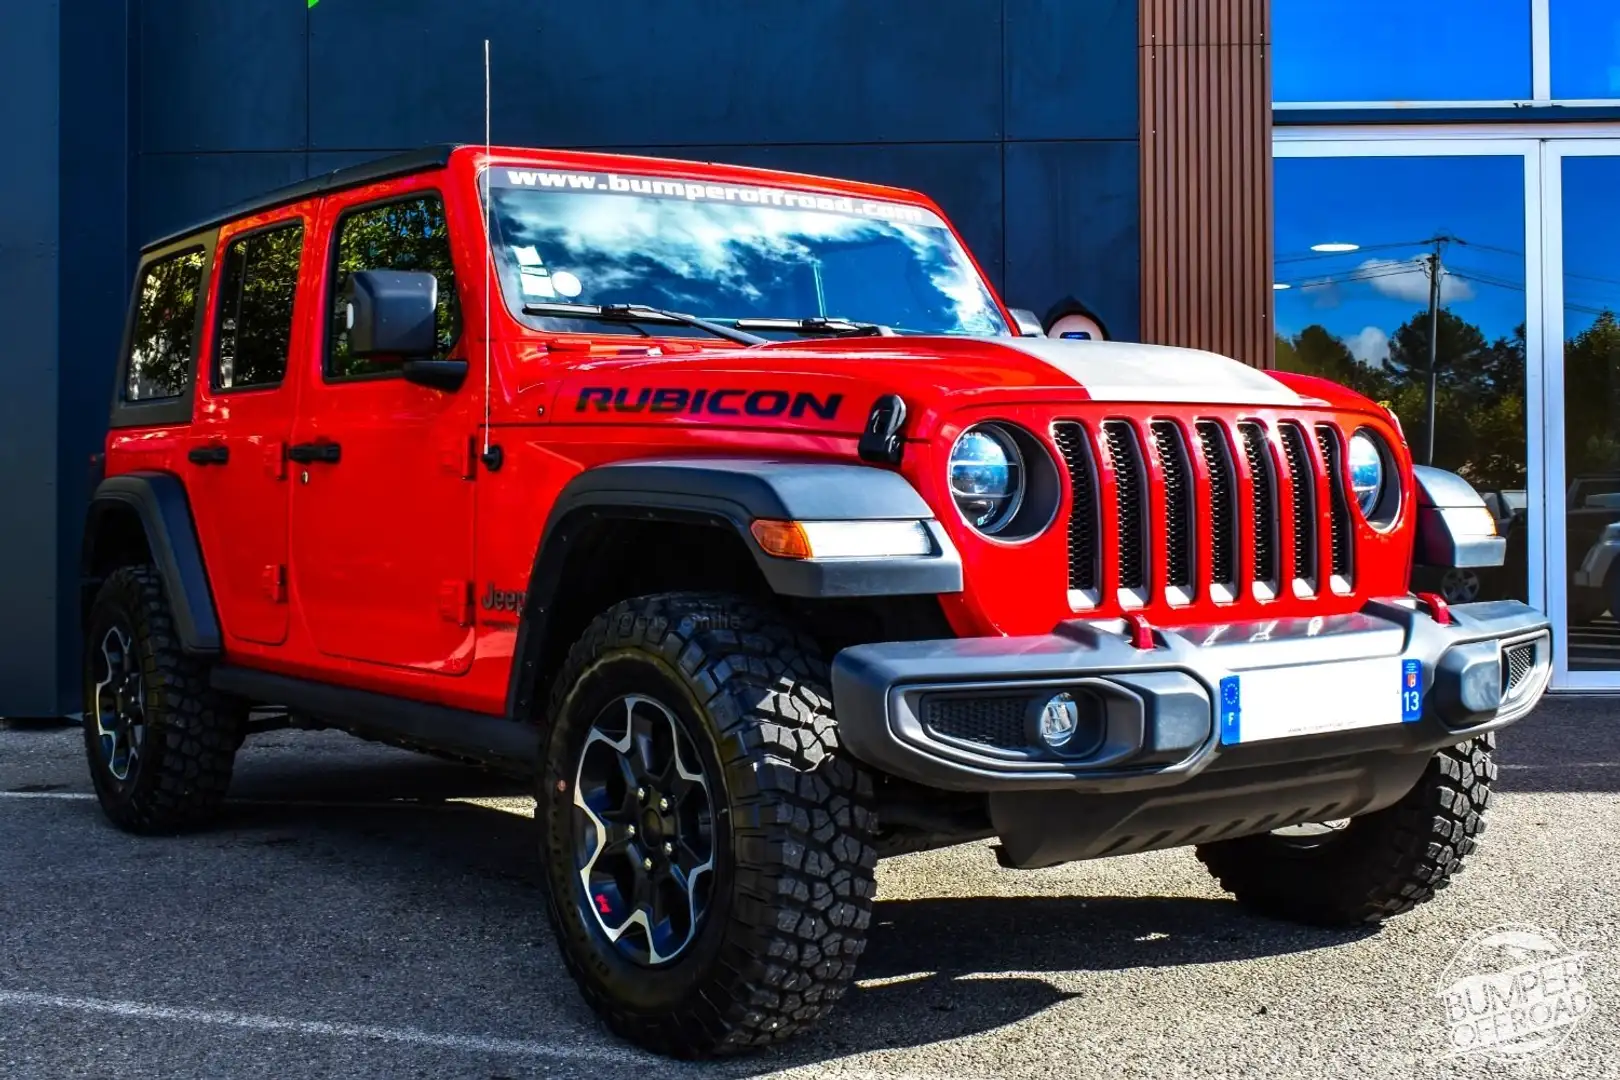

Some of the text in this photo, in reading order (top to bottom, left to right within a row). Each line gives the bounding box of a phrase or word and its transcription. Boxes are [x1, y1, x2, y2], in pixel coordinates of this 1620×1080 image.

[507, 169, 923, 222] www.bumperoffroad.com
[575, 387, 844, 420] RUBICON
[482, 581, 527, 617] Jeep
[1403, 691, 1420, 712] 13
[1227, 712, 1235, 727] F
